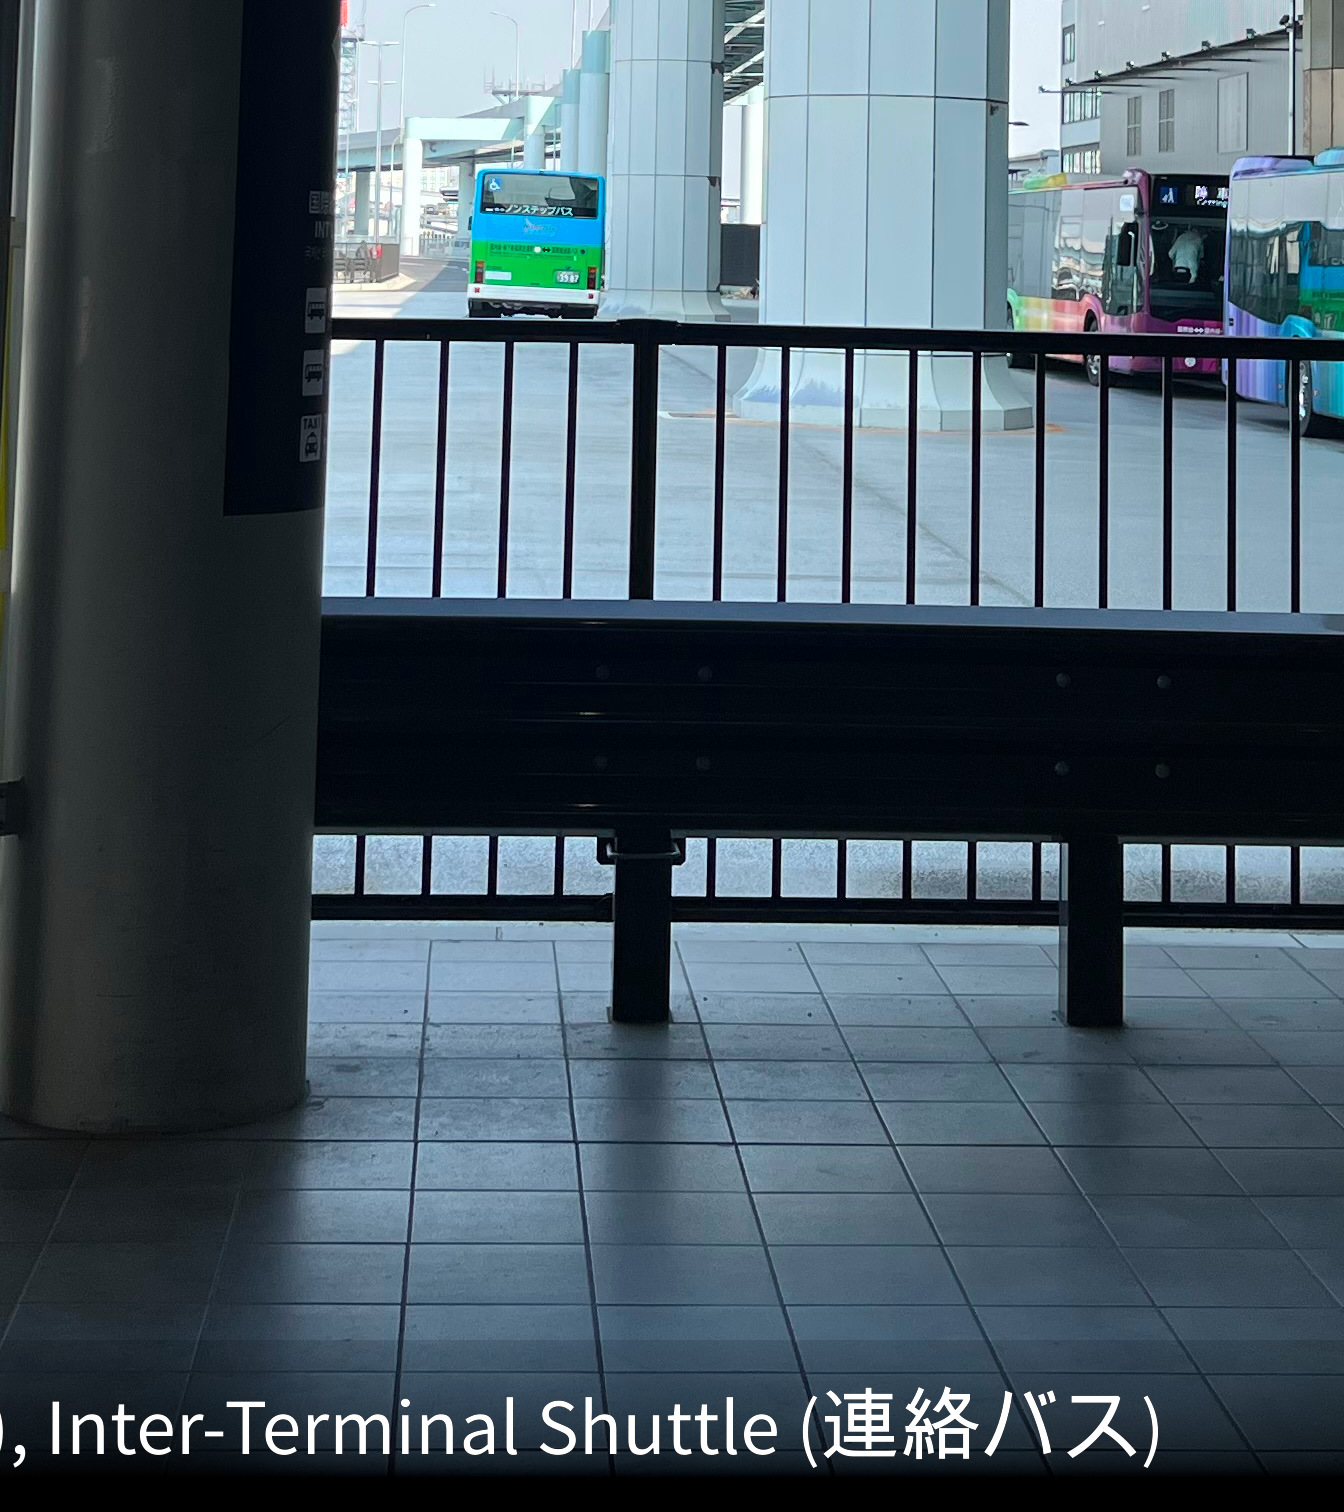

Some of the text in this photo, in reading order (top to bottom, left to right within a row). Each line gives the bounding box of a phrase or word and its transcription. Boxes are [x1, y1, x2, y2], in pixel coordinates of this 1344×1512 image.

[505, 204, 574, 217] ノンステップバス
